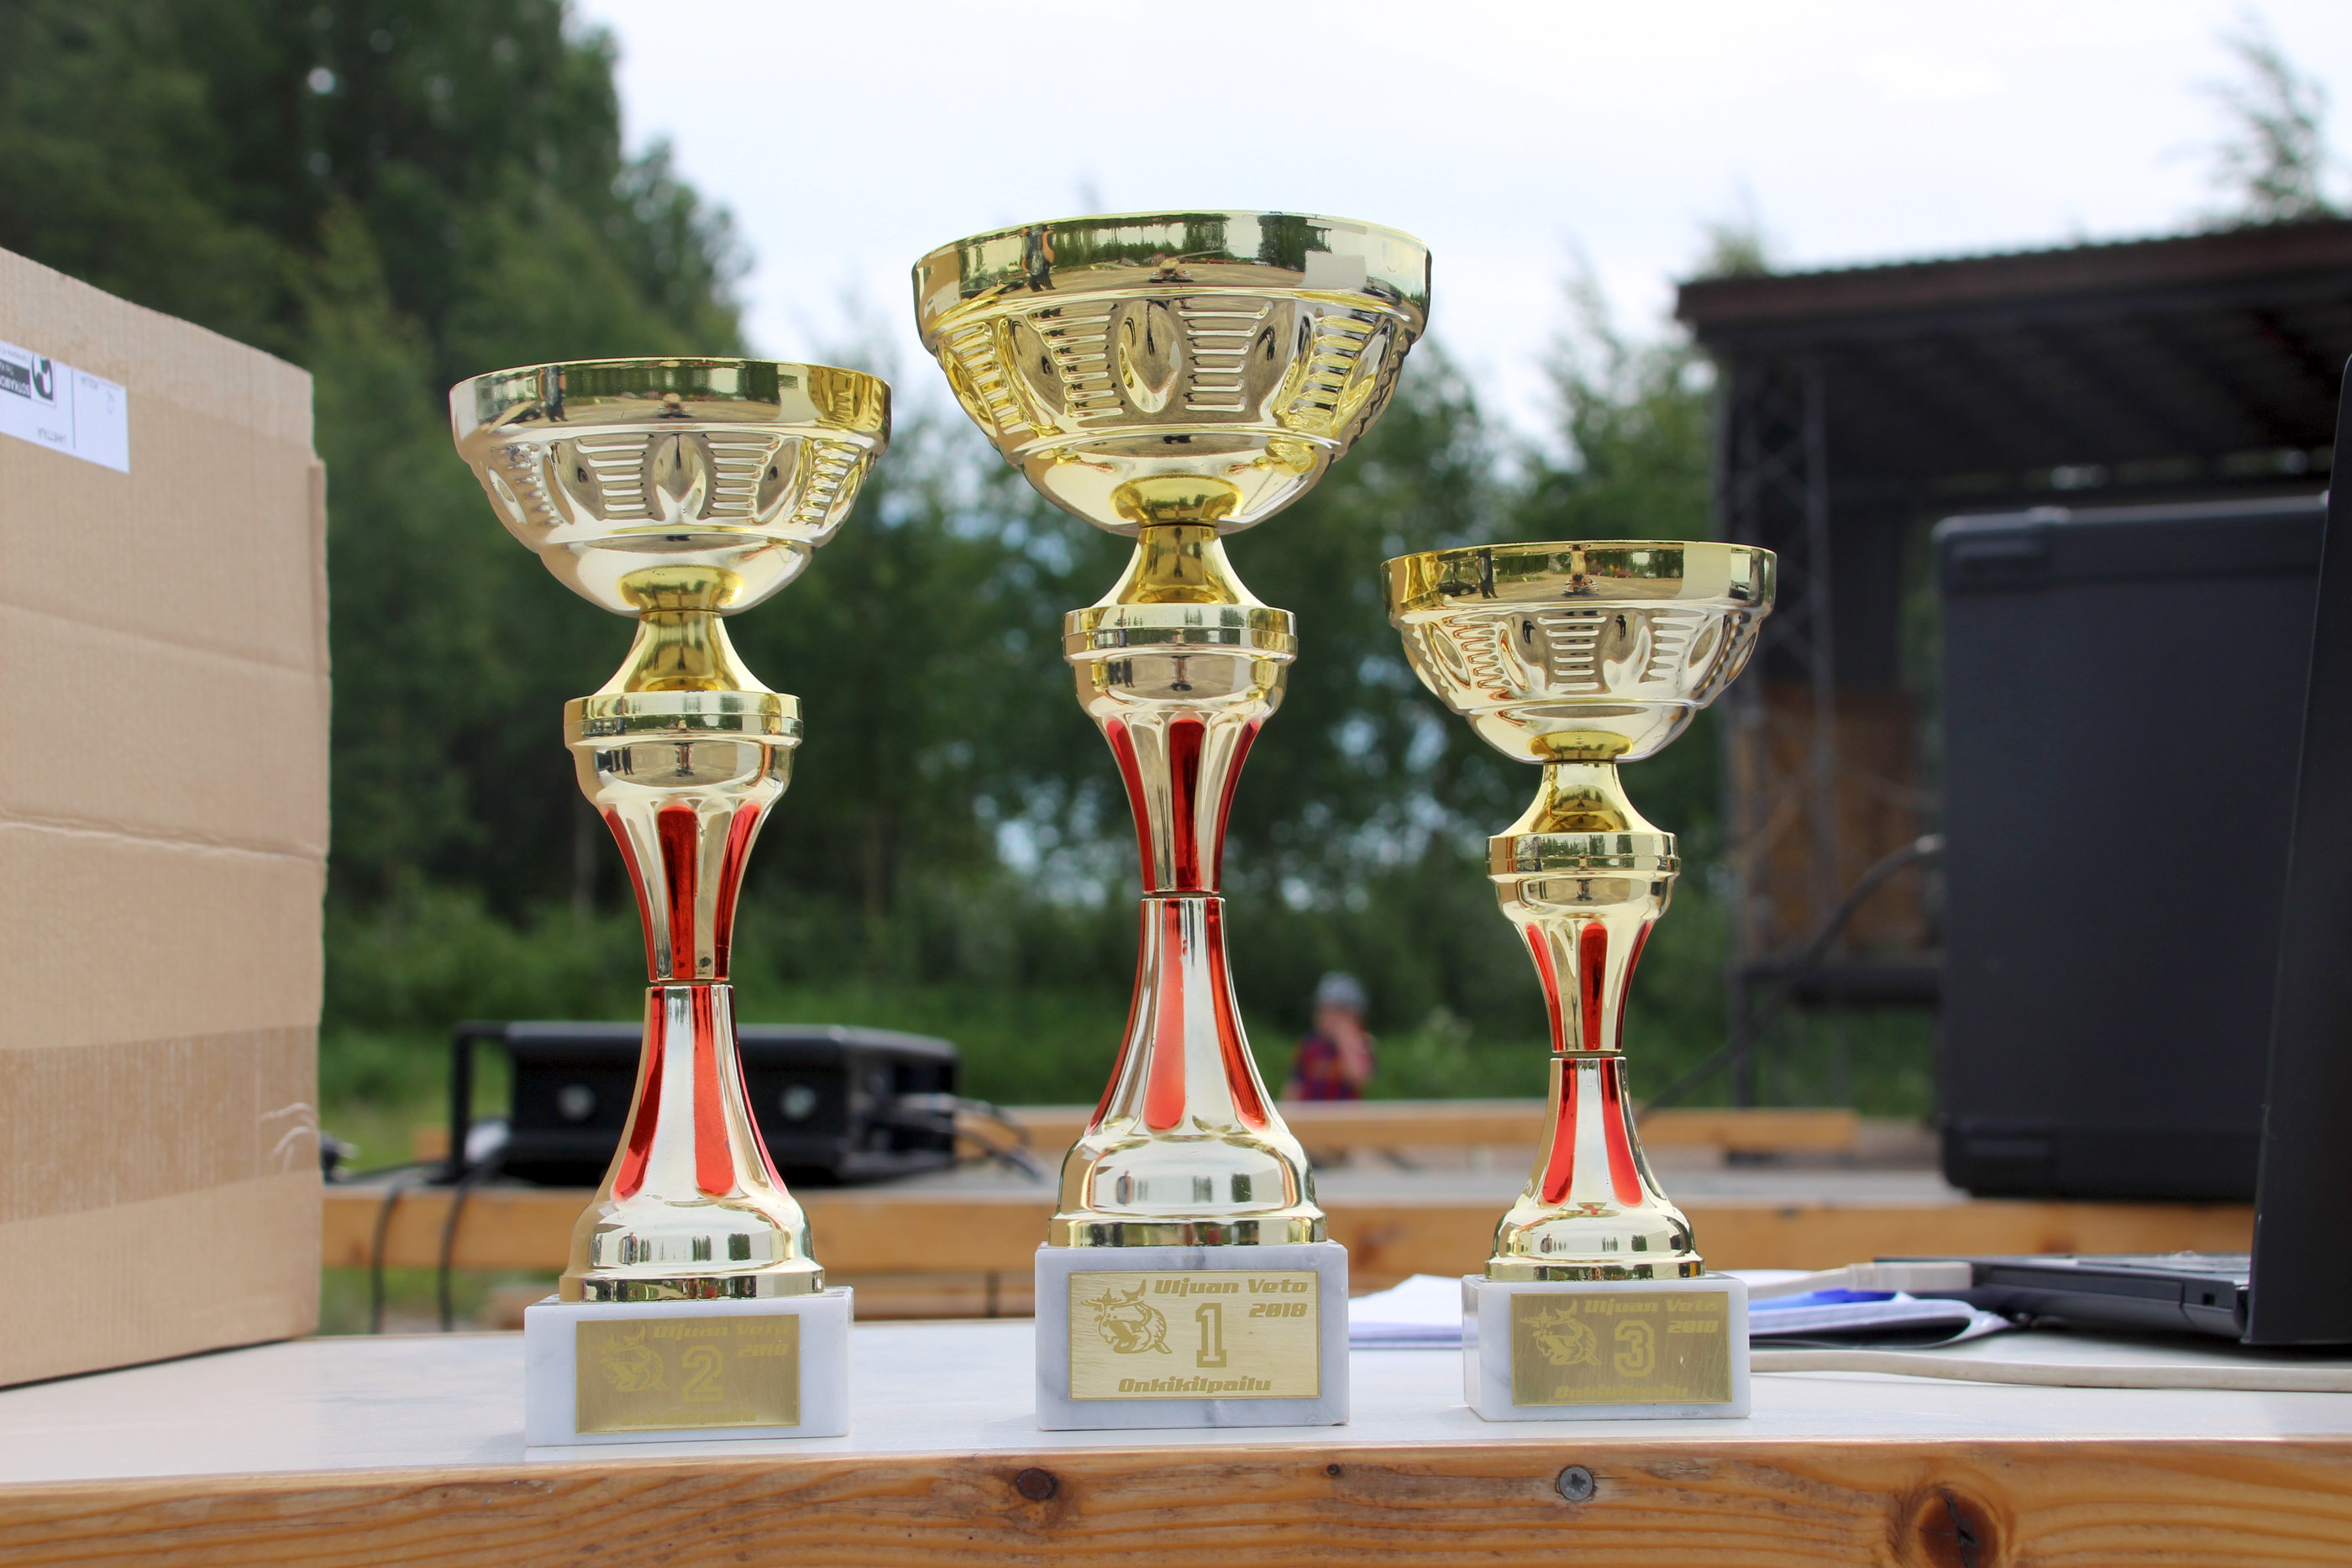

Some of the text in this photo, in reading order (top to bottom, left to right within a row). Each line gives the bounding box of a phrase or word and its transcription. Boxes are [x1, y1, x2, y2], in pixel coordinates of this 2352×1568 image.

[1154, 1277, 1308, 1297] Uljuan Veto
[1248, 1303, 1308, 1318] 2018
[1583, 1298, 1719, 1315] Uljuan Veto
[653, 1323, 790, 1341] Uljuan Veto
[1195, 1303, 1227, 1368] 1
[1667, 1320, 1719, 1334] 2018
[1614, 1319, 1655, 1377] 3
[681, 1345, 724, 1403] 2
[1118, 1376, 1271, 1393] Onkikilpailu
